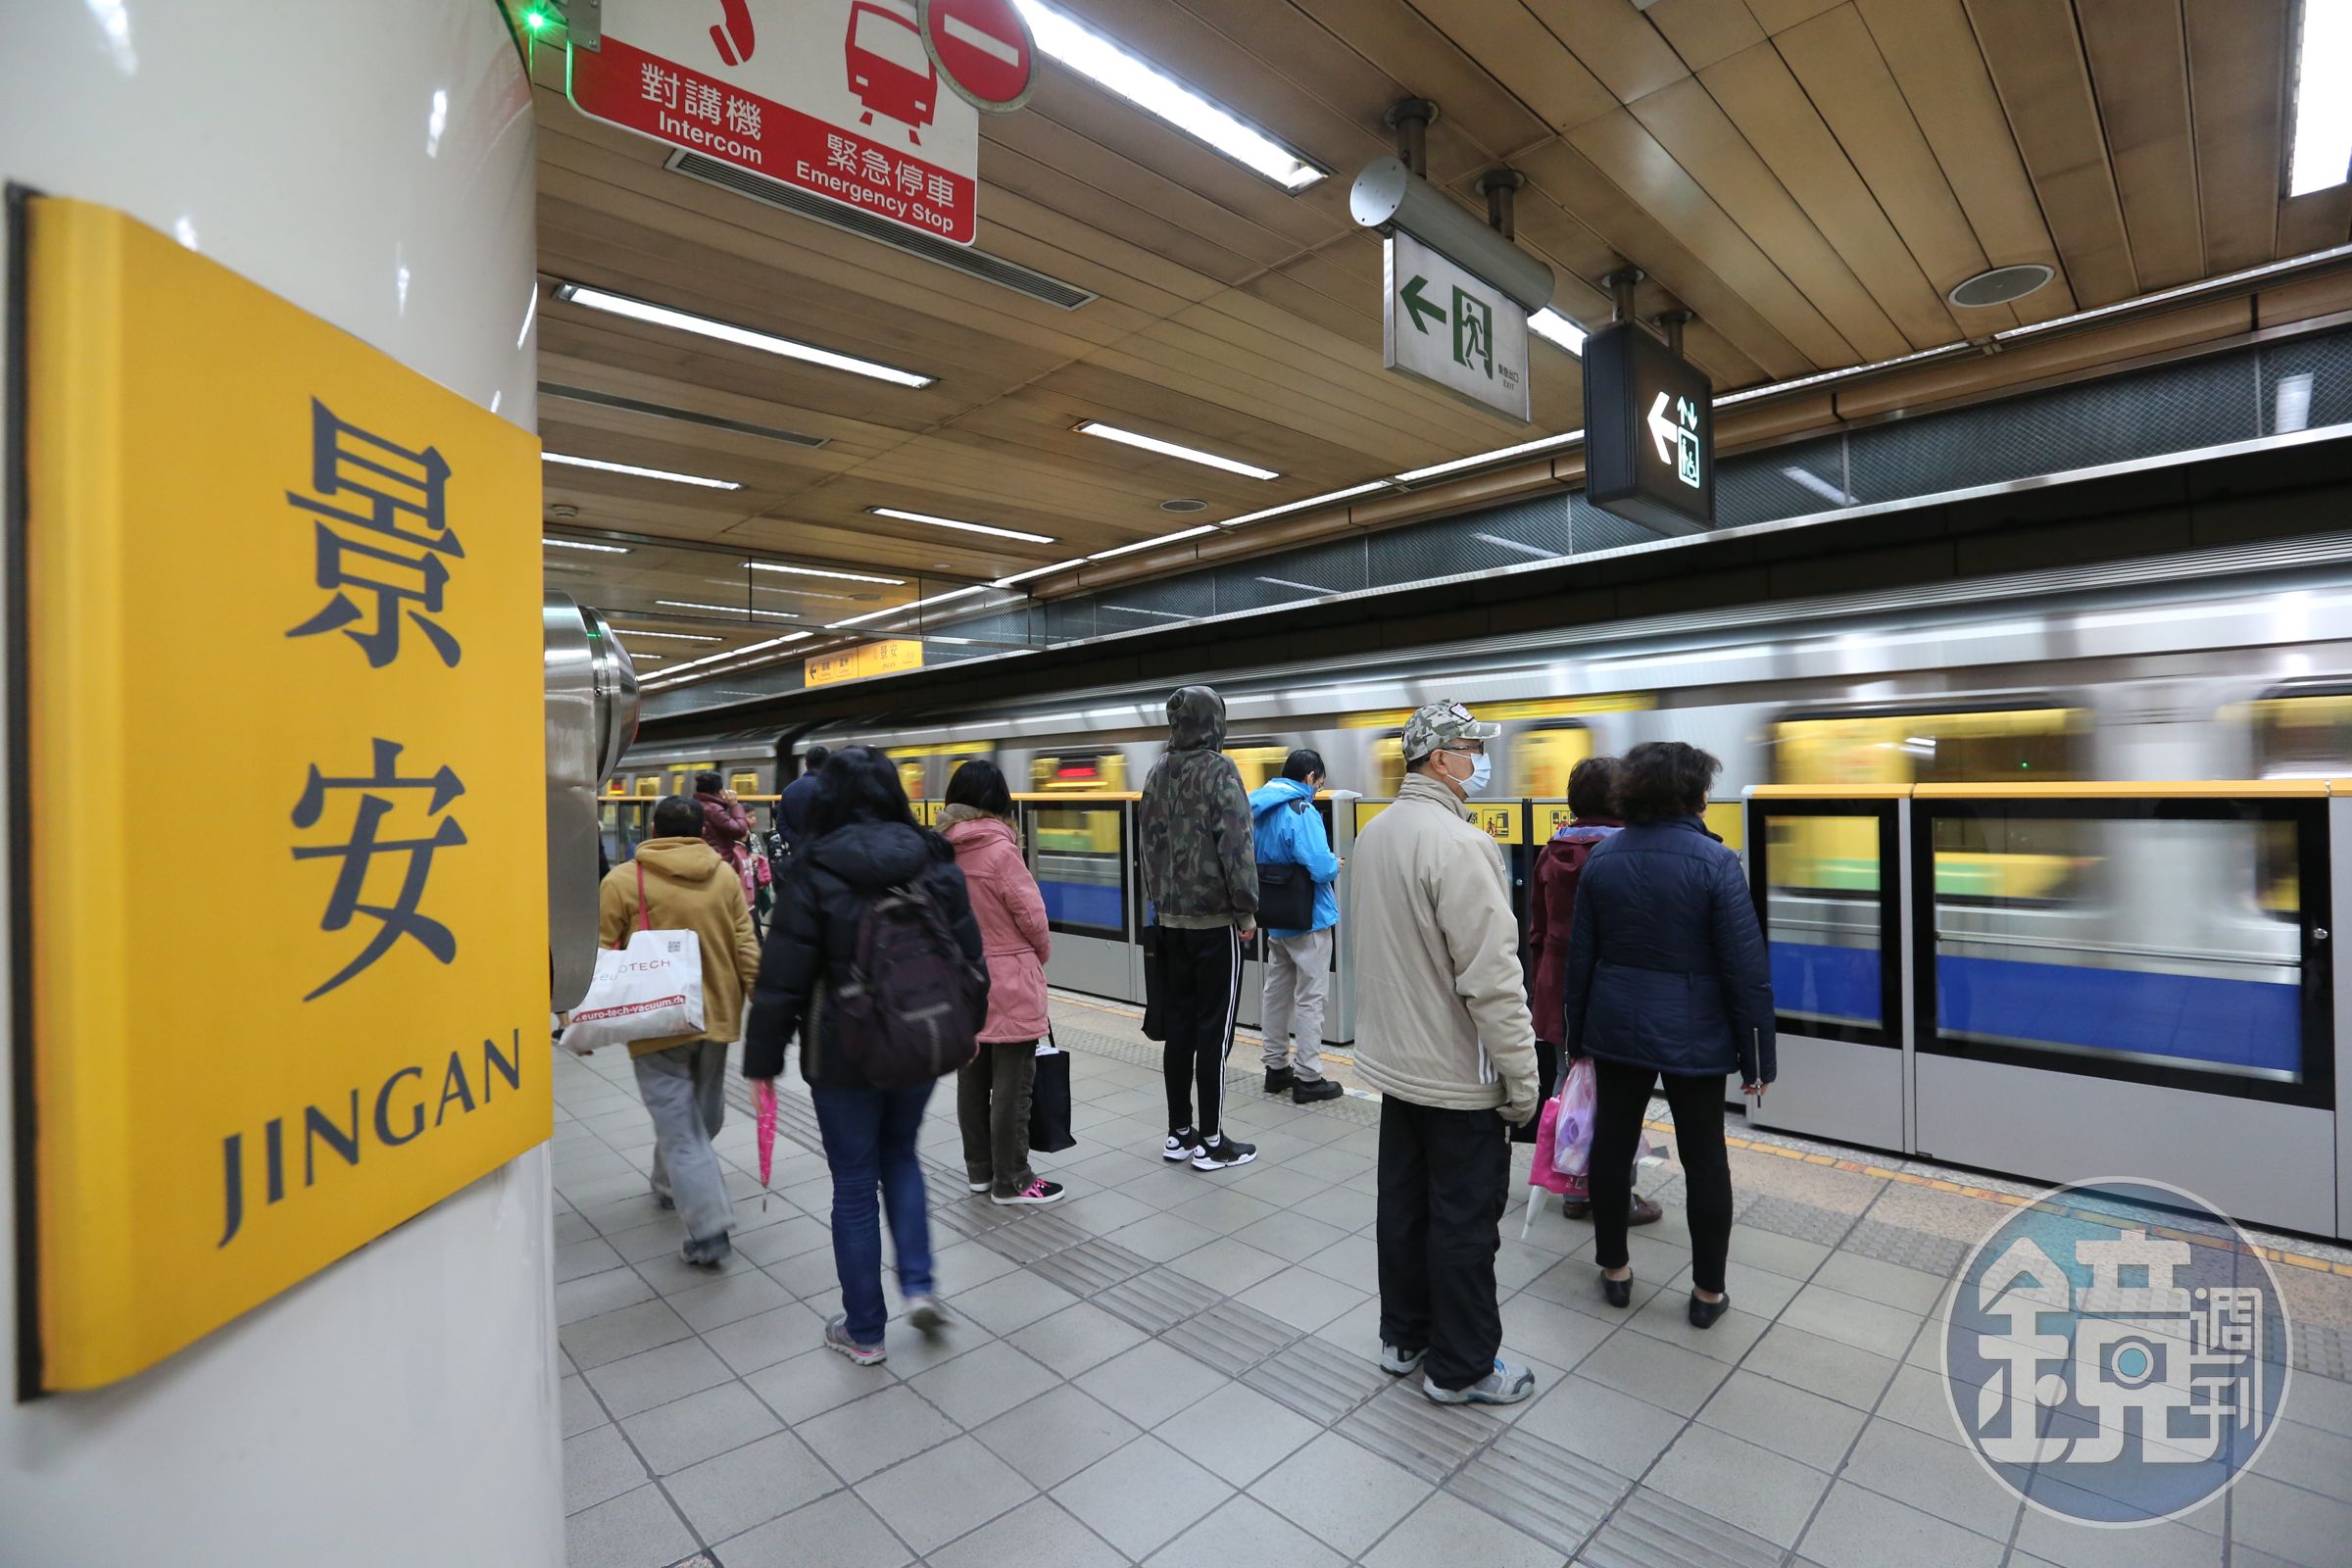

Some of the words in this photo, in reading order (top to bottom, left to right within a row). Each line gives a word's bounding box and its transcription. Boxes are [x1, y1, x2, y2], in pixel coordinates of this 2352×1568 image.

[641, 63, 762, 141] 對講機
[659, 111, 762, 165] Intercom
[796, 162, 907, 218] Emergency
[911, 203, 955, 233] Stop
[827, 134, 955, 208] 緊急停車
[284, 394, 467, 1003] 景安
[218, 1030, 521, 1250] JINGAN
